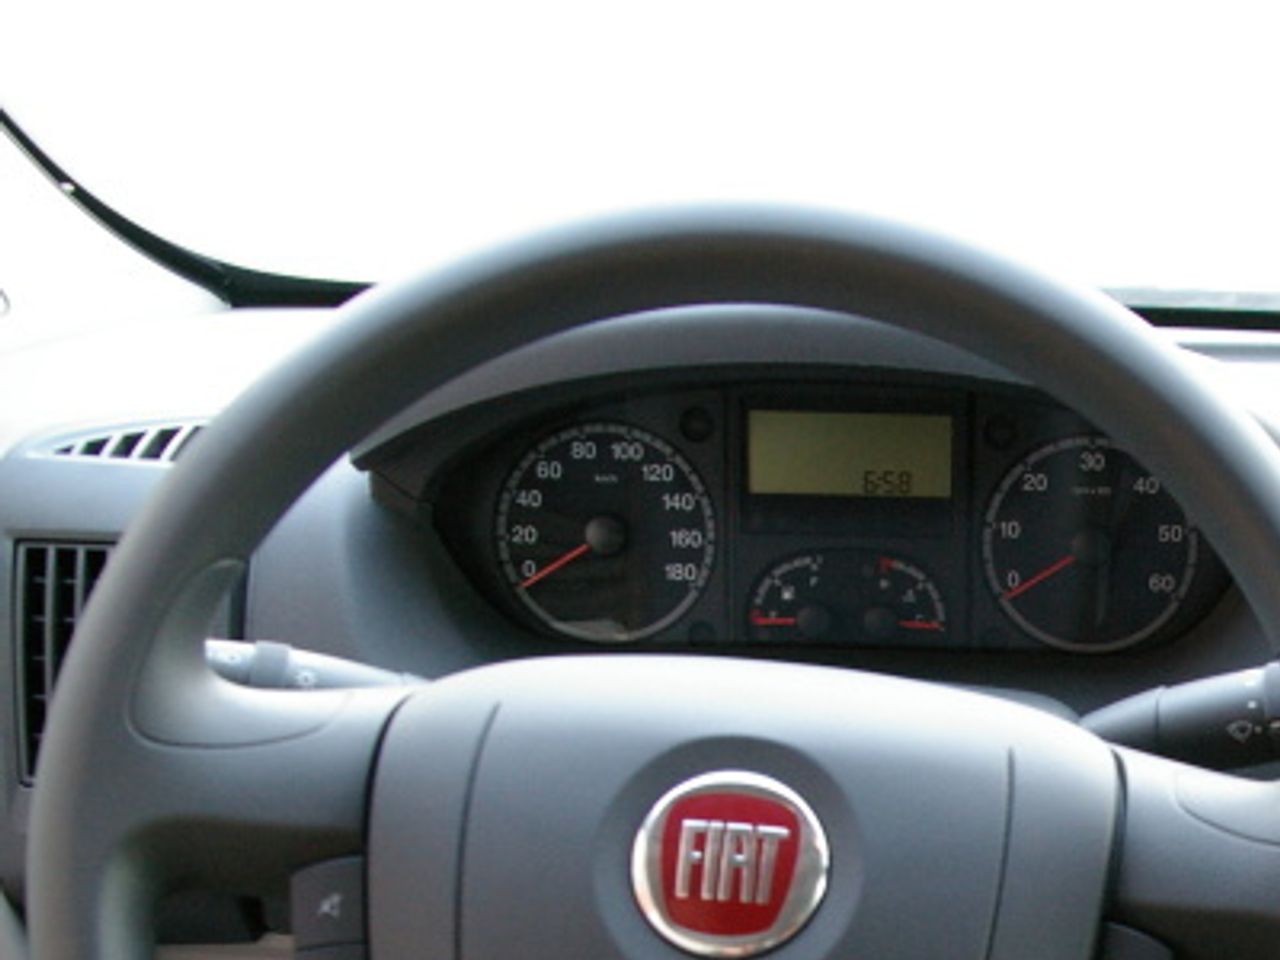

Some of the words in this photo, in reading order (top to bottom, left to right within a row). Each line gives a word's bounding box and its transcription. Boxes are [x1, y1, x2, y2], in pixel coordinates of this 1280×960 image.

[571, 442, 597, 459] 80
[611, 442, 644, 460] 100
[536, 461, 562, 479] 60
[1079, 453, 1105, 471] 30
[642, 464, 674, 482] 120
[1022, 473, 1048, 491] 20
[1133, 477, 1160, 494] 40
[515, 489, 542, 507] 40
[662, 493, 695, 511] 140
[512, 525, 538, 543] 20
[669, 530, 702, 548] 160
[1000, 521, 1021, 539] 10
[1158, 525, 1182, 542] 50
[522, 560, 536, 577] 0
[665, 563, 696, 581] 180
[1008, 570, 1020, 587] 0
[1148, 574, 1175, 591] 60
[675, 818, 790, 905] FIAT
